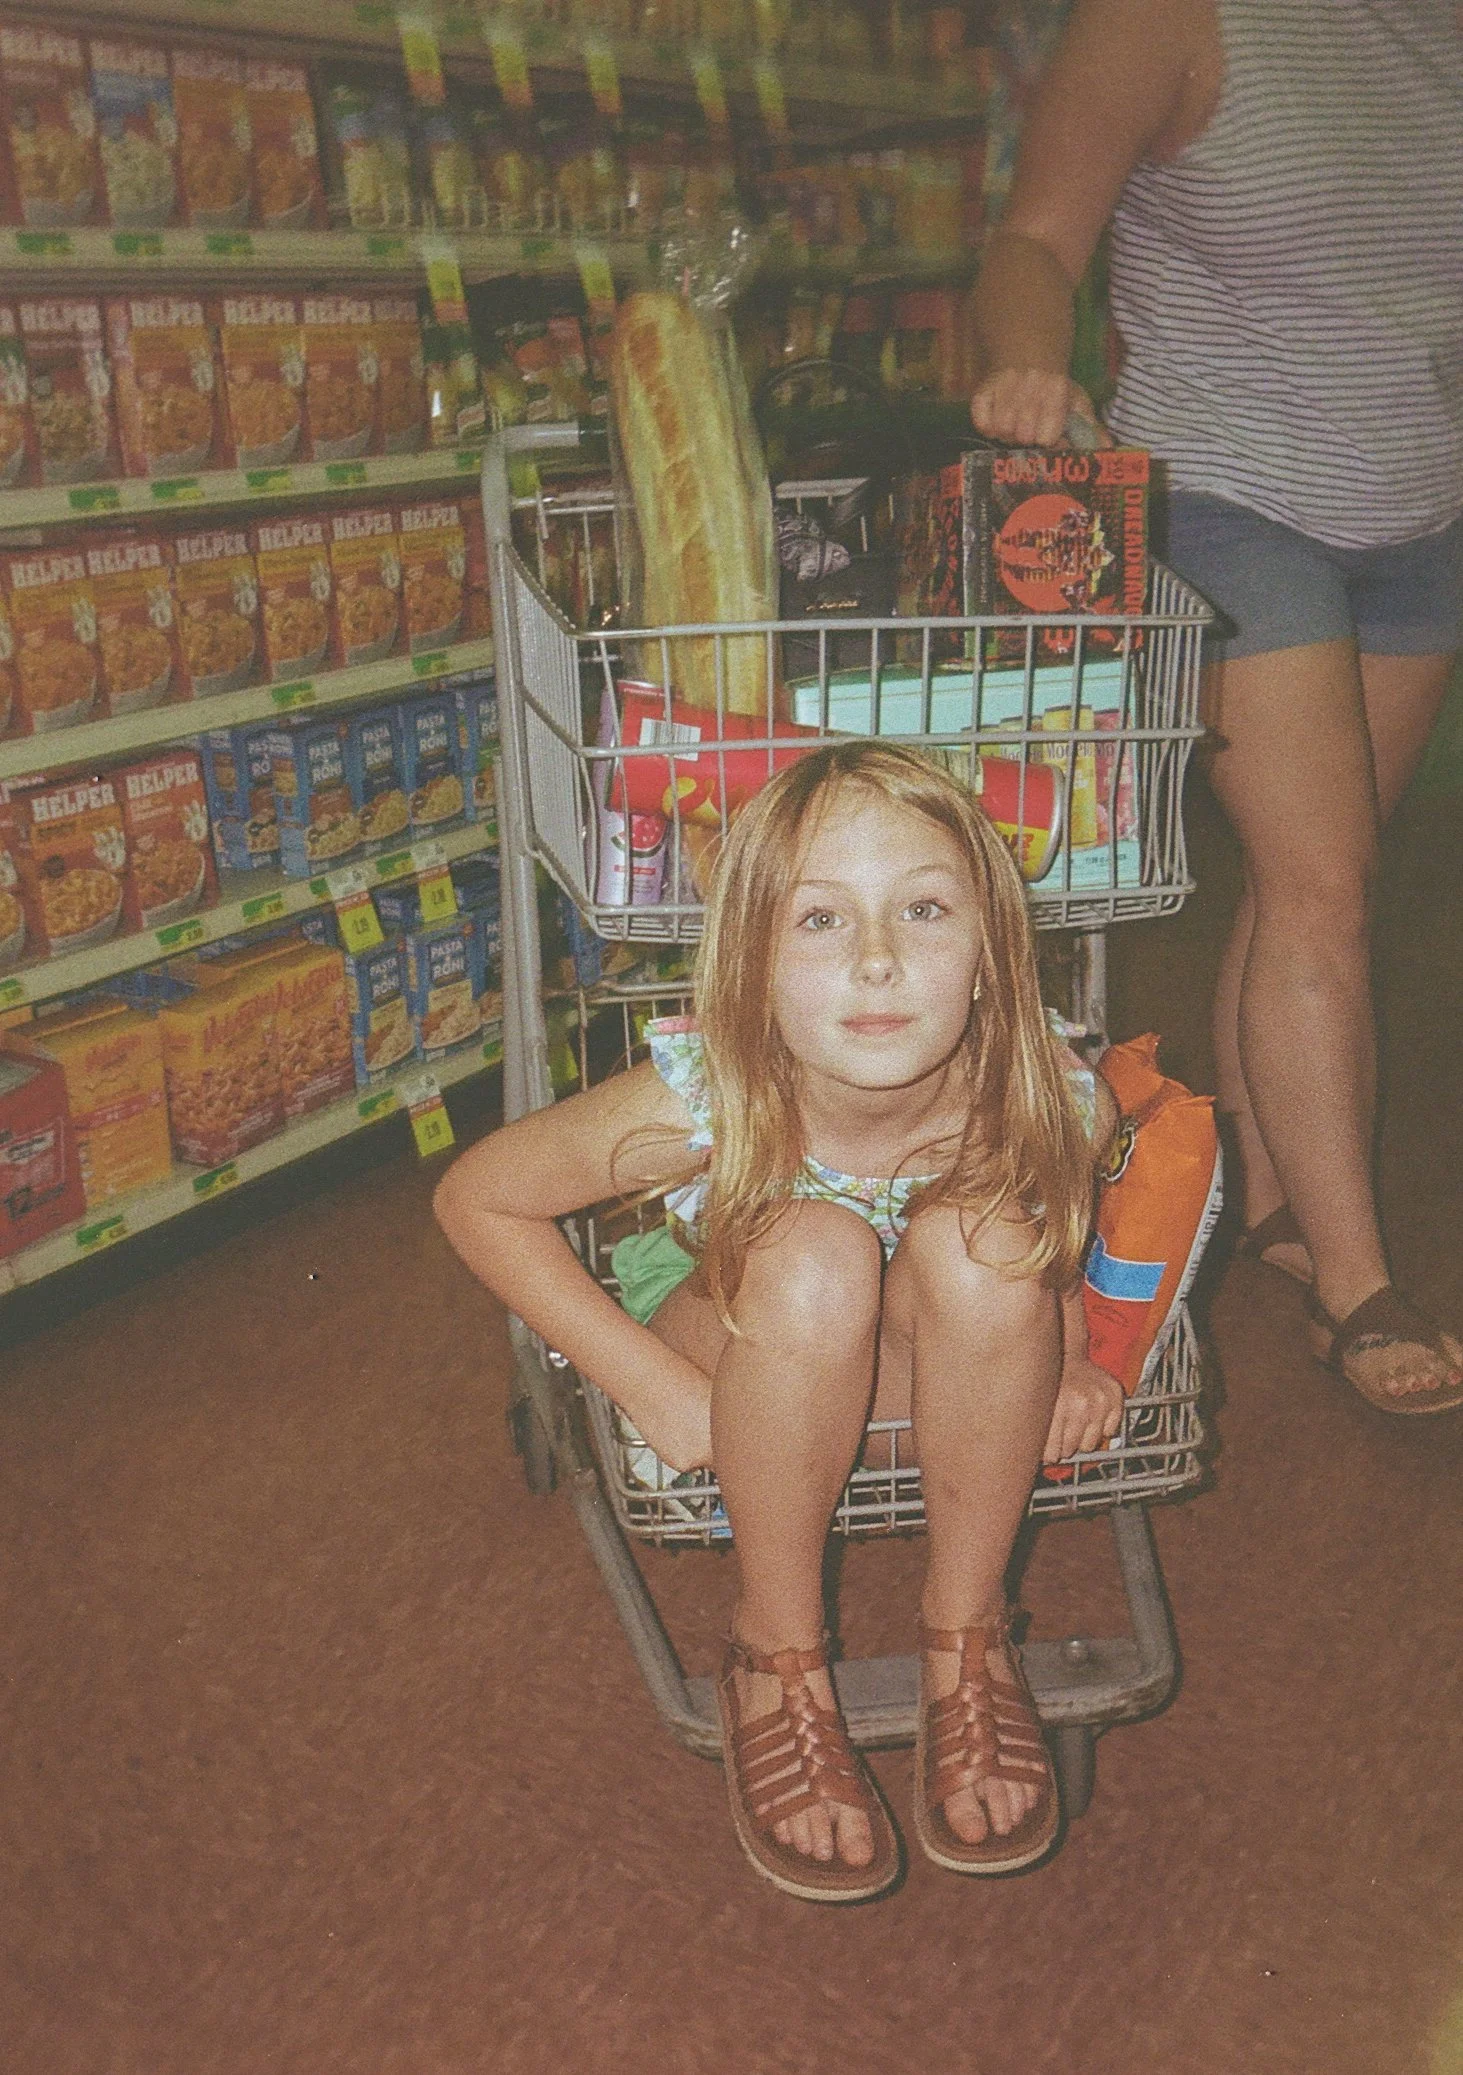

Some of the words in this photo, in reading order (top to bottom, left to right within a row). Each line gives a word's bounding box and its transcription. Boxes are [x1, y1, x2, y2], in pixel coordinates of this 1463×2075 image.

[332, 512, 393, 541] HELPER
[401, 506, 460, 532] HELPER
[176, 532, 248, 564] HELPER
[258, 522, 323, 551] HELPER
[10, 555, 85, 589] HELPER
[88, 543, 161, 576] HELPER
[420, 731, 448, 753] RONI
[126, 761, 199, 800] HELPER
[32, 783, 116, 824] HELPER
[430, 939, 464, 959] PASTA
[432, 957, 465, 980] RONI
